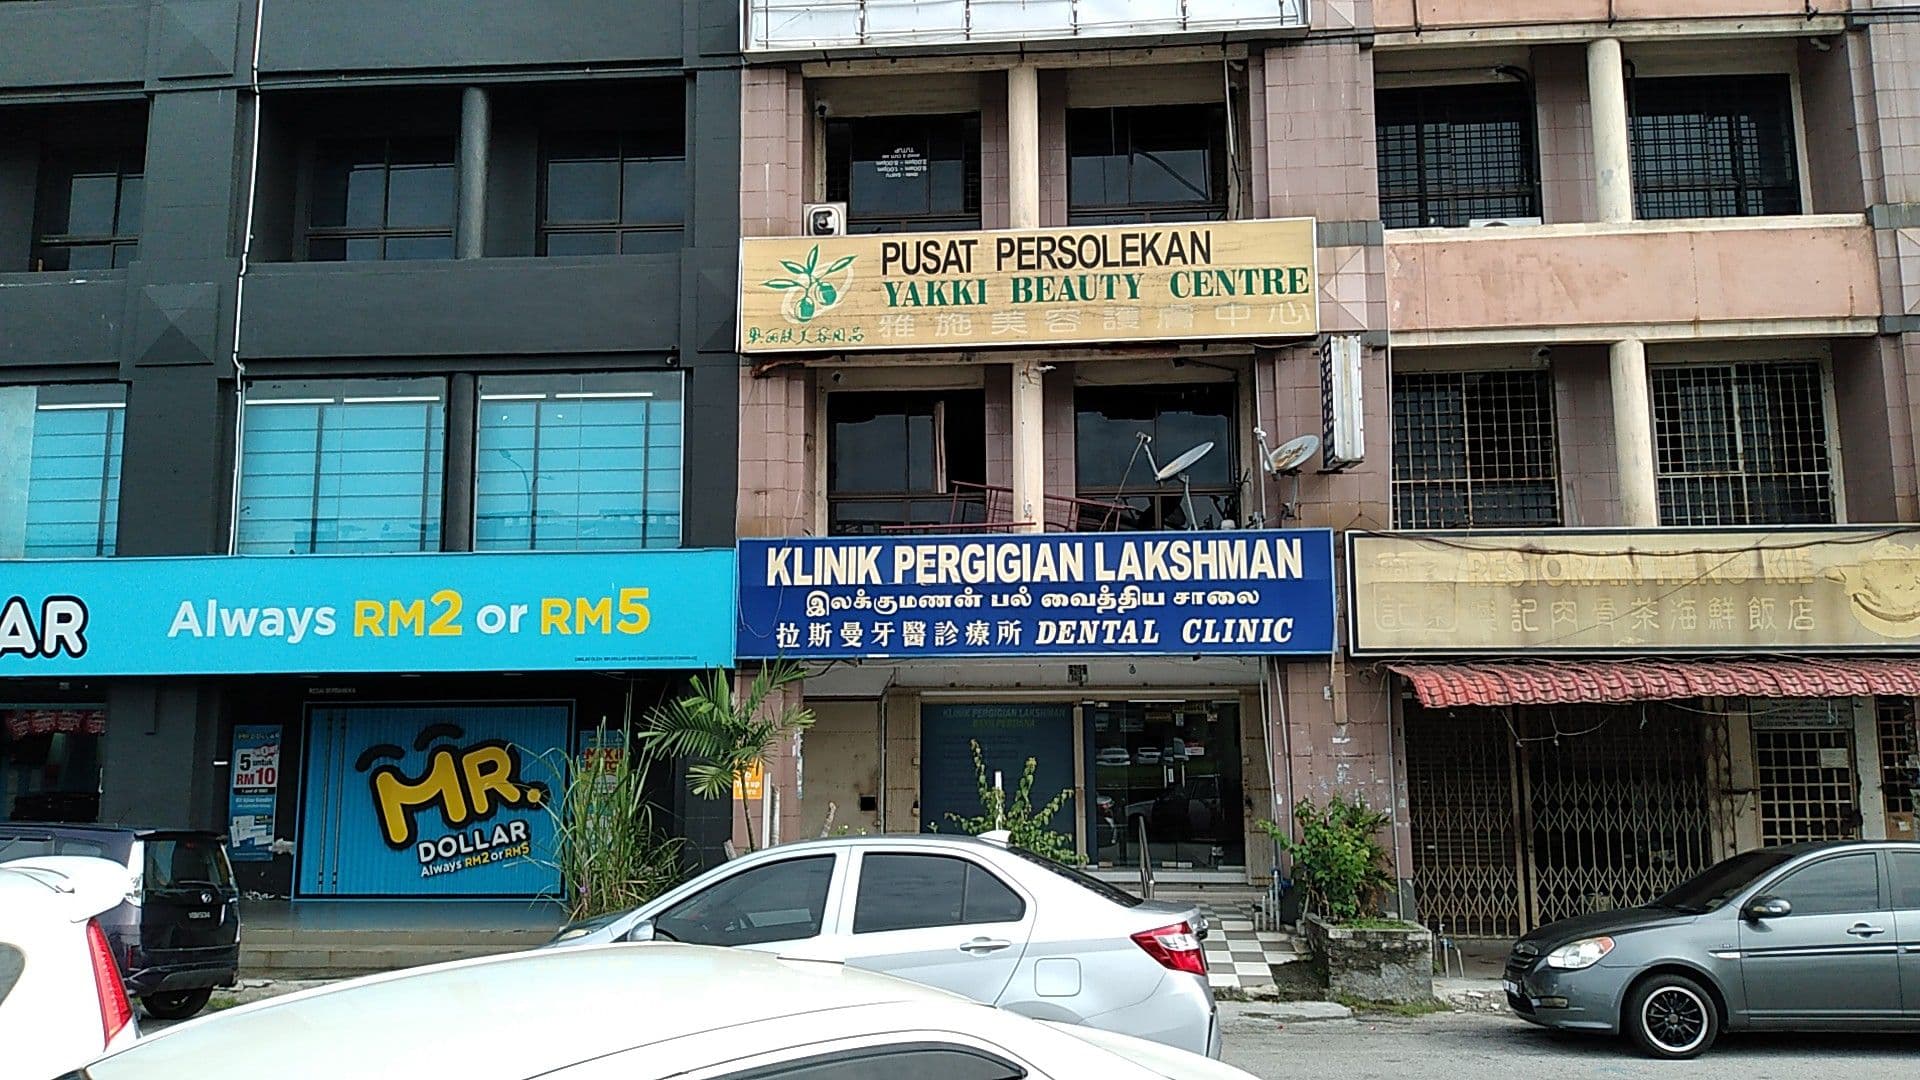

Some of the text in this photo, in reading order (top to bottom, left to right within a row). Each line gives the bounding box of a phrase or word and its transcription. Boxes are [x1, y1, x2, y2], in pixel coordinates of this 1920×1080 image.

[881, 230, 1211, 276] PUSAT PERSOLEKAN
[882, 266, 1310, 307] YAKKI BEAUTY CENTRE
[767, 538, 1303, 586] KLINIK PERGIGIAN LAKSHMAN
[1466, 552, 1643, 588] RESTORAN
[1764, 548, 1814, 584] KIE
[167, 587, 651, 644] Always RM2 or RM5
[991, 586, 1032, 608] பல்
[1041, 585, 1165, 614] வைத்திய
[1173, 590, 1260, 606] சாலை
[776, 619, 1023, 648] 拉斯曼牙醫診療所
[1035, 617, 1293, 645] DENTAL CLINIC
[236, 767, 276, 785] RM10
[239, 753, 273, 771] 5 untuk
[374, 744, 543, 845] MR.
[417, 820, 527, 863] DOLLAR
[420, 843, 530, 878] Always RM2 or RM5
